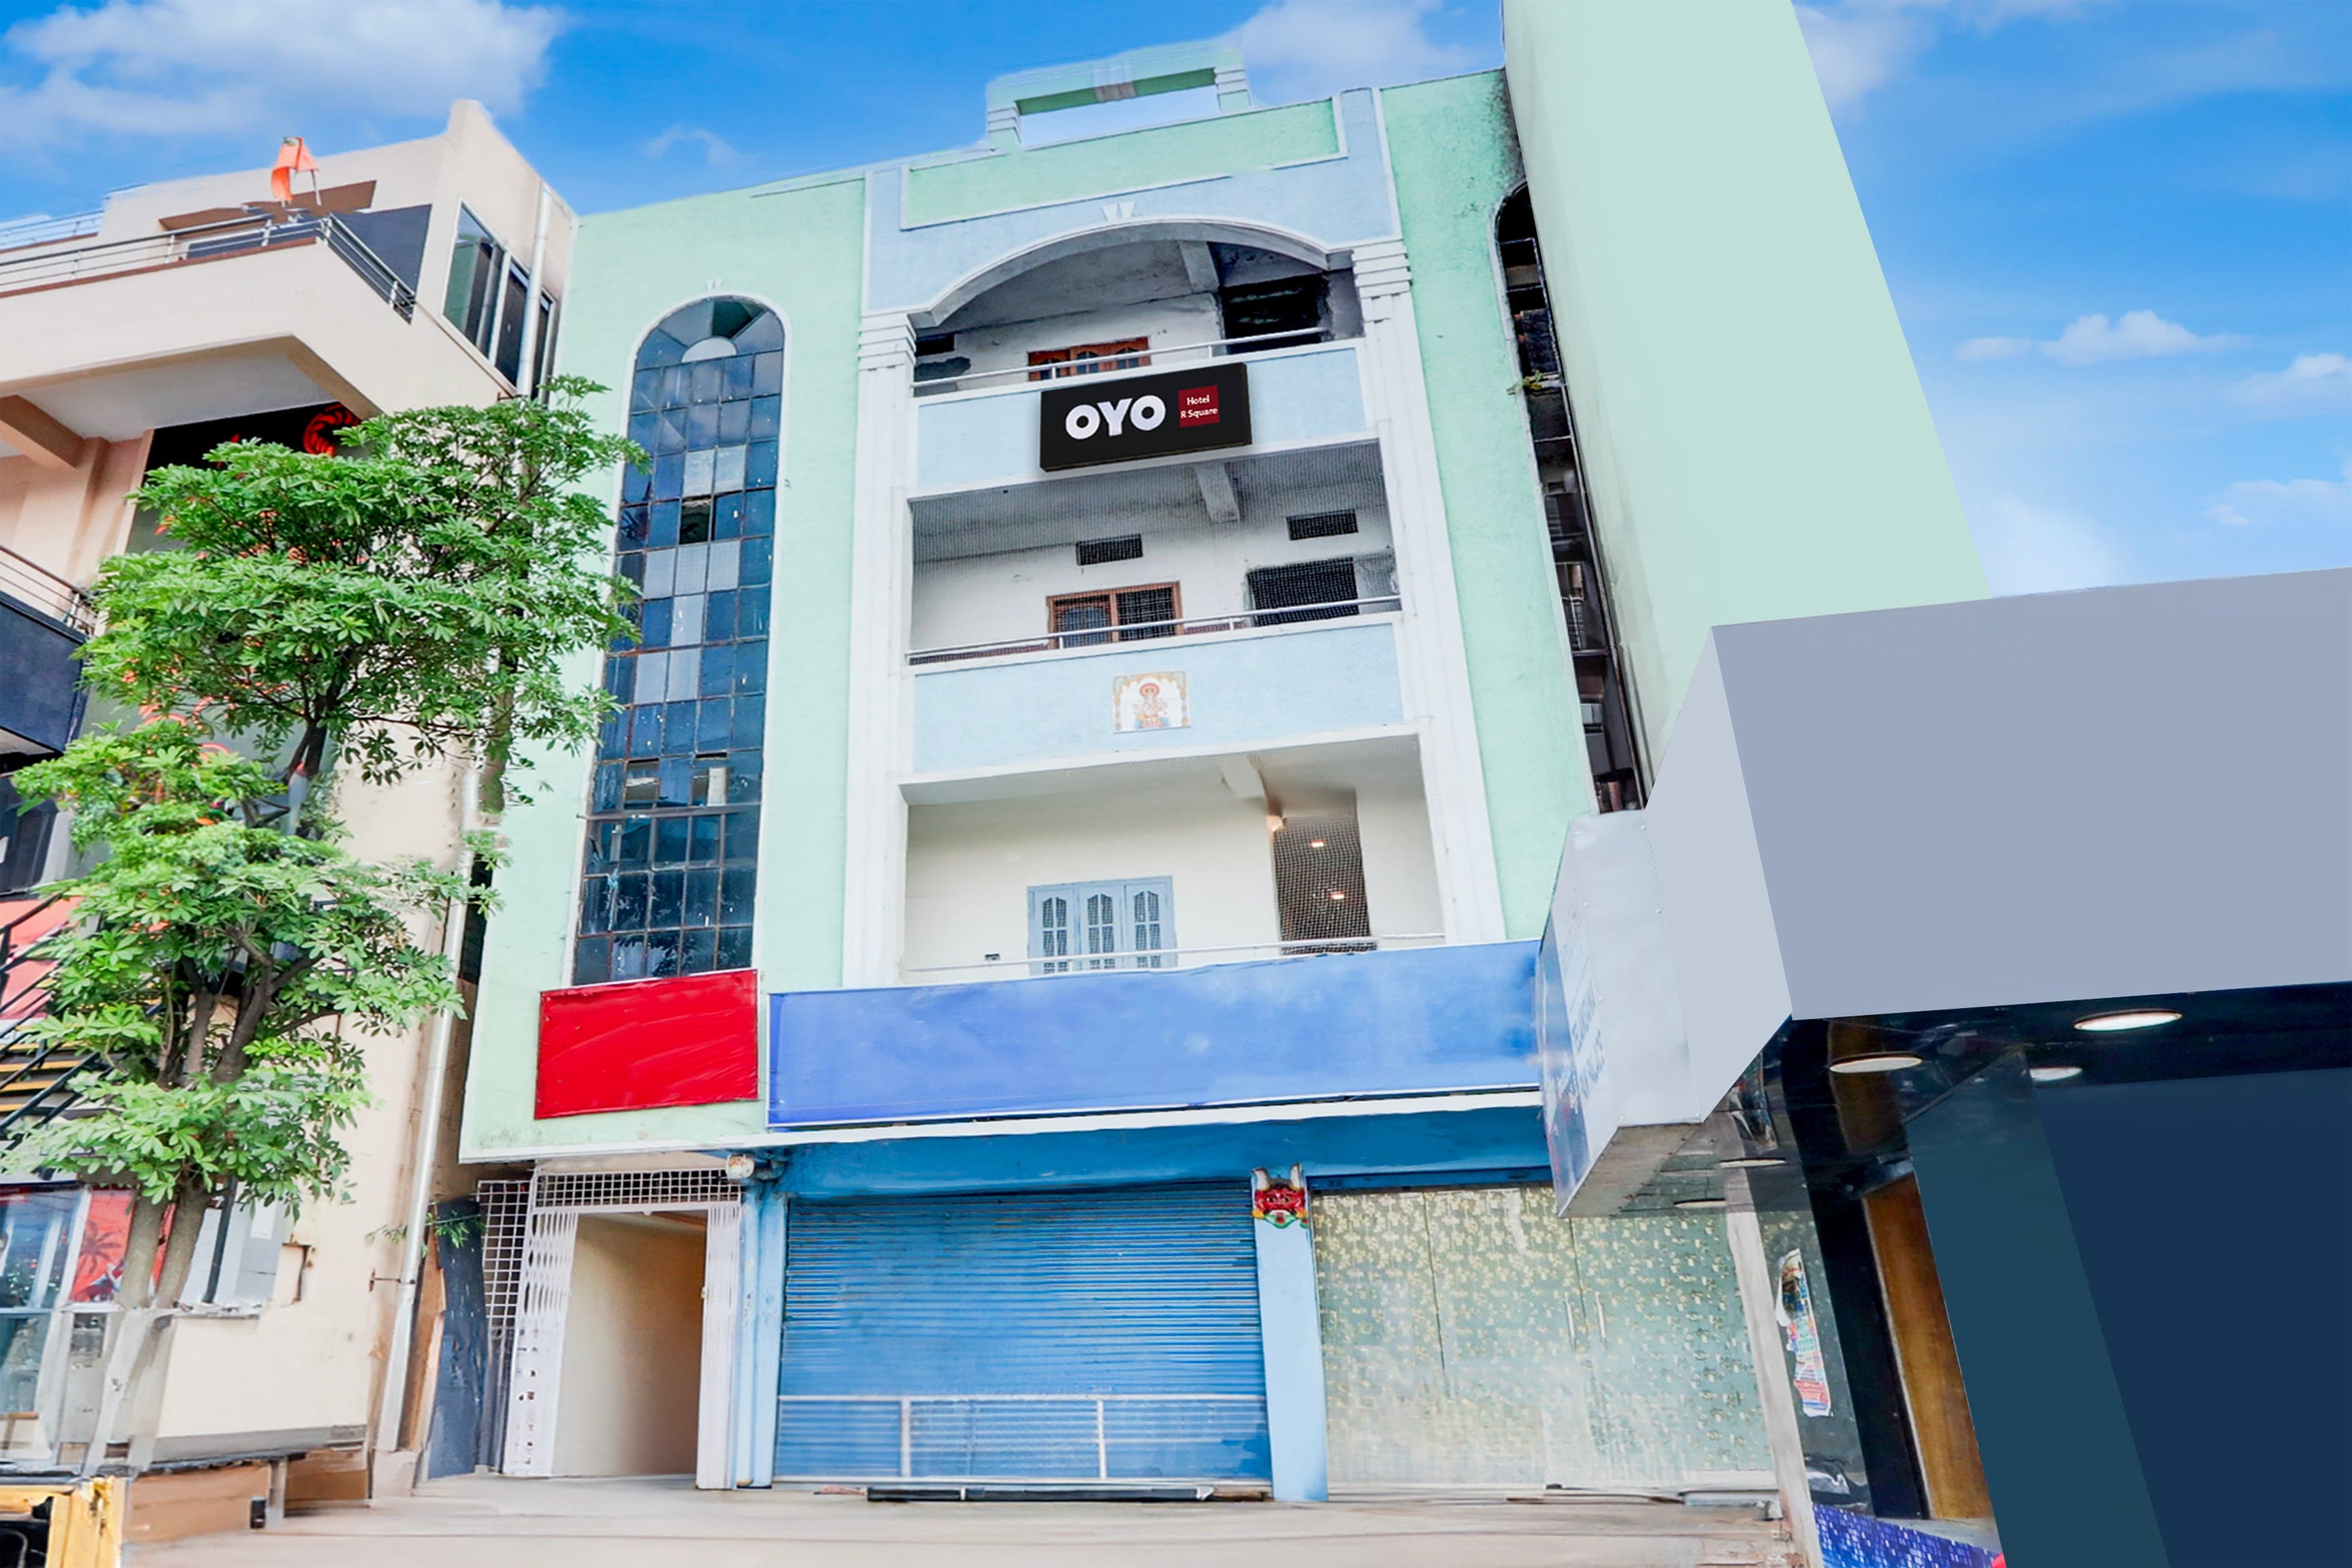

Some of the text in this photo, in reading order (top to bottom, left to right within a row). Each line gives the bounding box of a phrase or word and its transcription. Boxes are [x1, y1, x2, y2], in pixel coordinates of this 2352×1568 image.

[1186, 394, 1210, 406] Hotel
[1065, 395, 1166, 440] OYO
[1180, 408, 1218, 419] R Square
